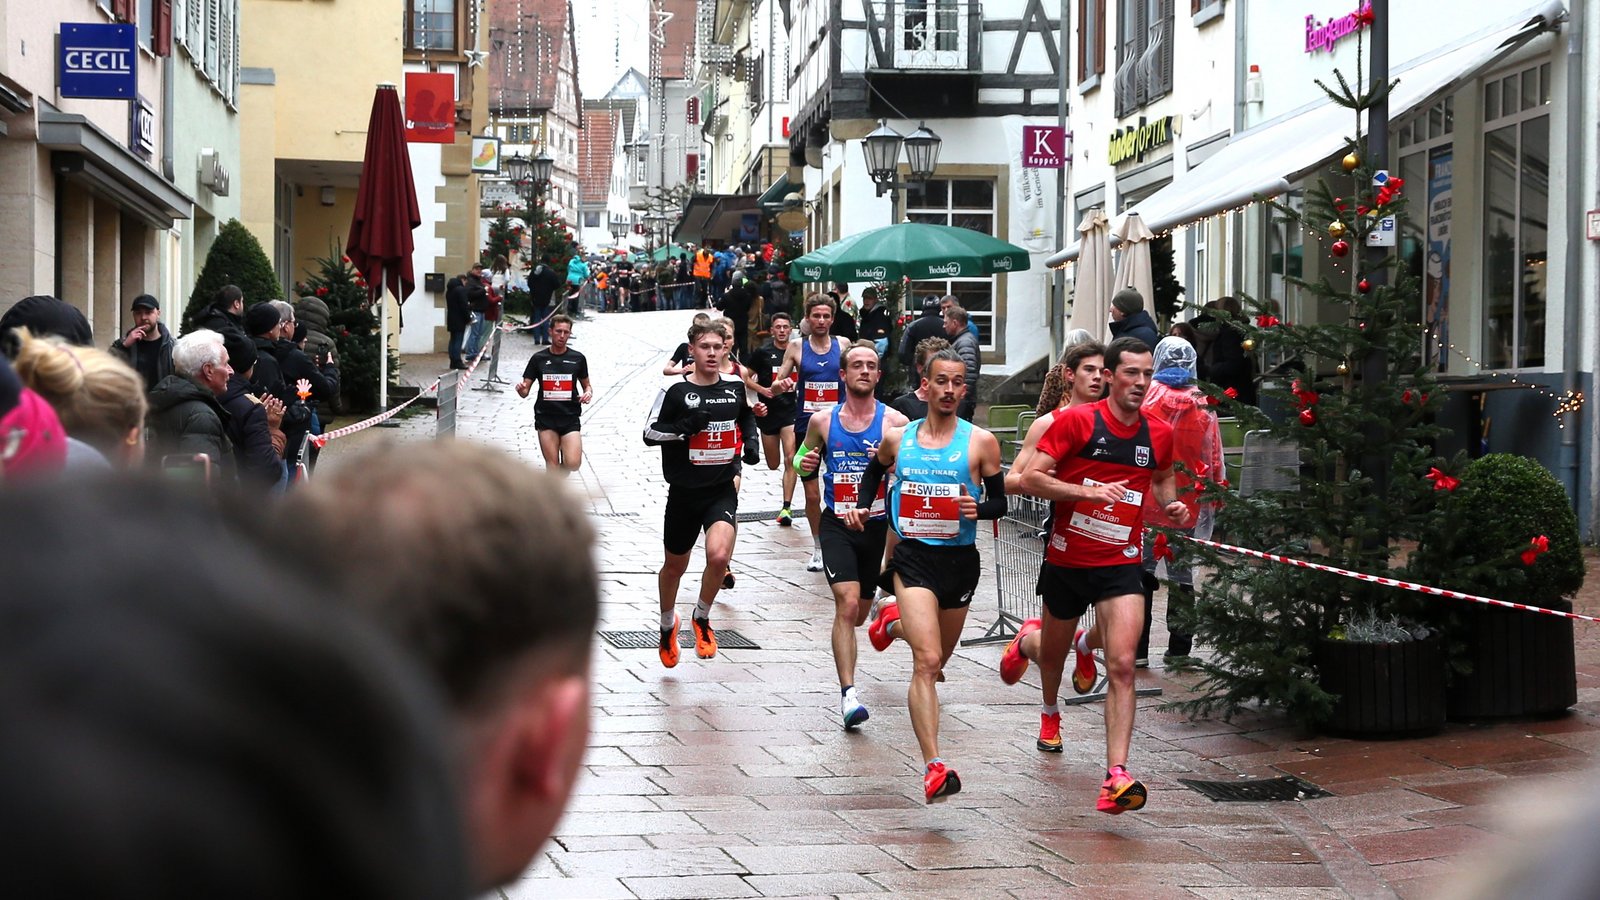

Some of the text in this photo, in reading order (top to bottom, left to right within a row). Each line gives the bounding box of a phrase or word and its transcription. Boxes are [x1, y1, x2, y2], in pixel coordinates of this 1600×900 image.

[65, 51, 130, 70] CECIL
[1139, 116, 1168, 152] OPTIK
[1033, 129, 1055, 155] K
[707, 432, 723, 442] 11
[852, 484, 859, 494] 1
[922, 496, 933, 510] 1
[914, 509, 941, 519] Simon
[1092, 509, 1120, 523] Florian
